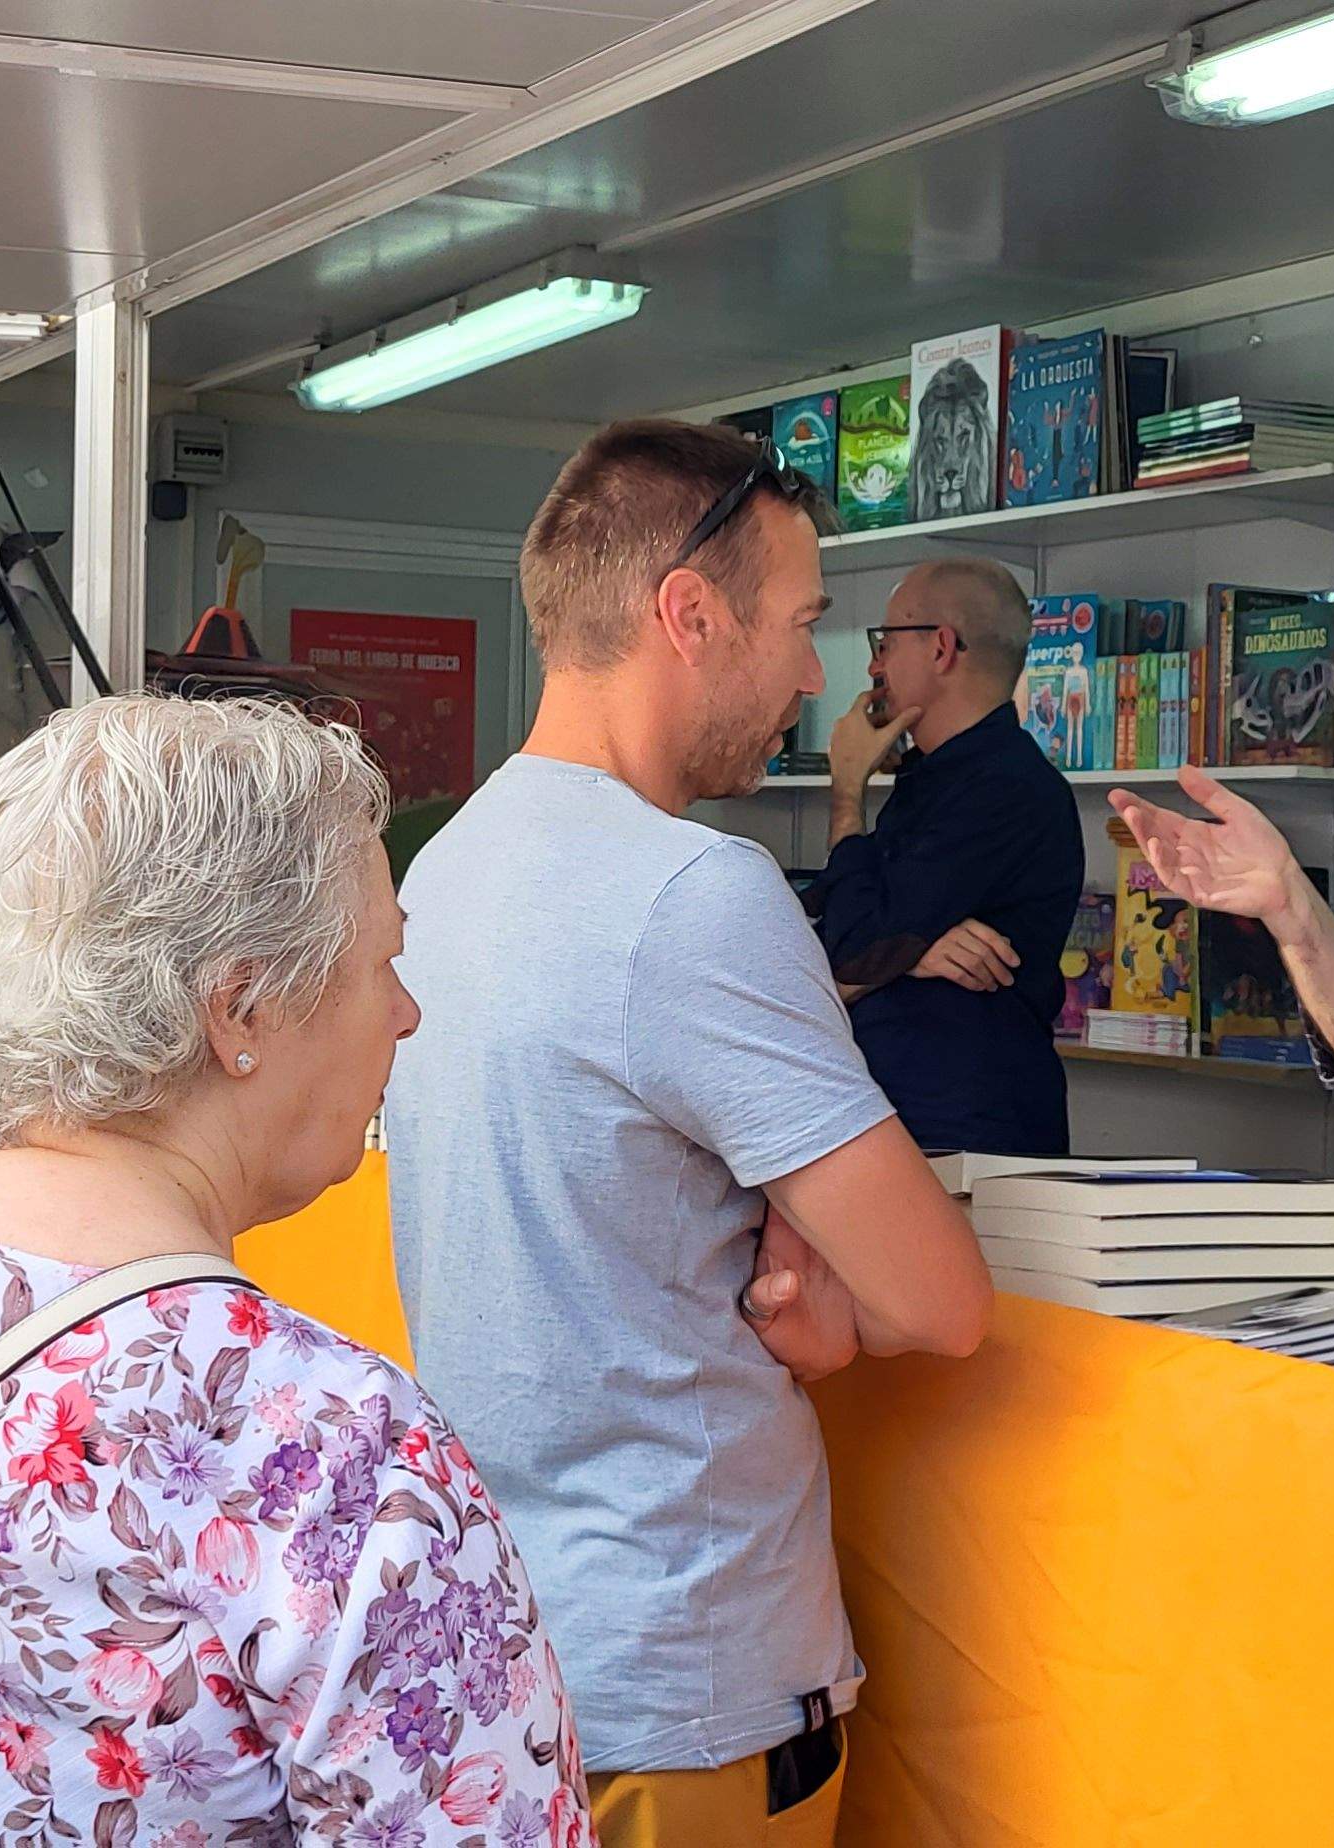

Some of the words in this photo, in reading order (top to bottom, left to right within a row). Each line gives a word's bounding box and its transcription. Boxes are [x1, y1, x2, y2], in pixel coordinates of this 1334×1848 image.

[1021, 368, 1036, 391] LA
[1040, 356, 1094, 386] ORQUESTA
[1270, 614, 1302, 630] MUSEO
[1244, 628, 1327, 655] DINOSAURIOS
[417, 654, 460, 672] HUESCA
